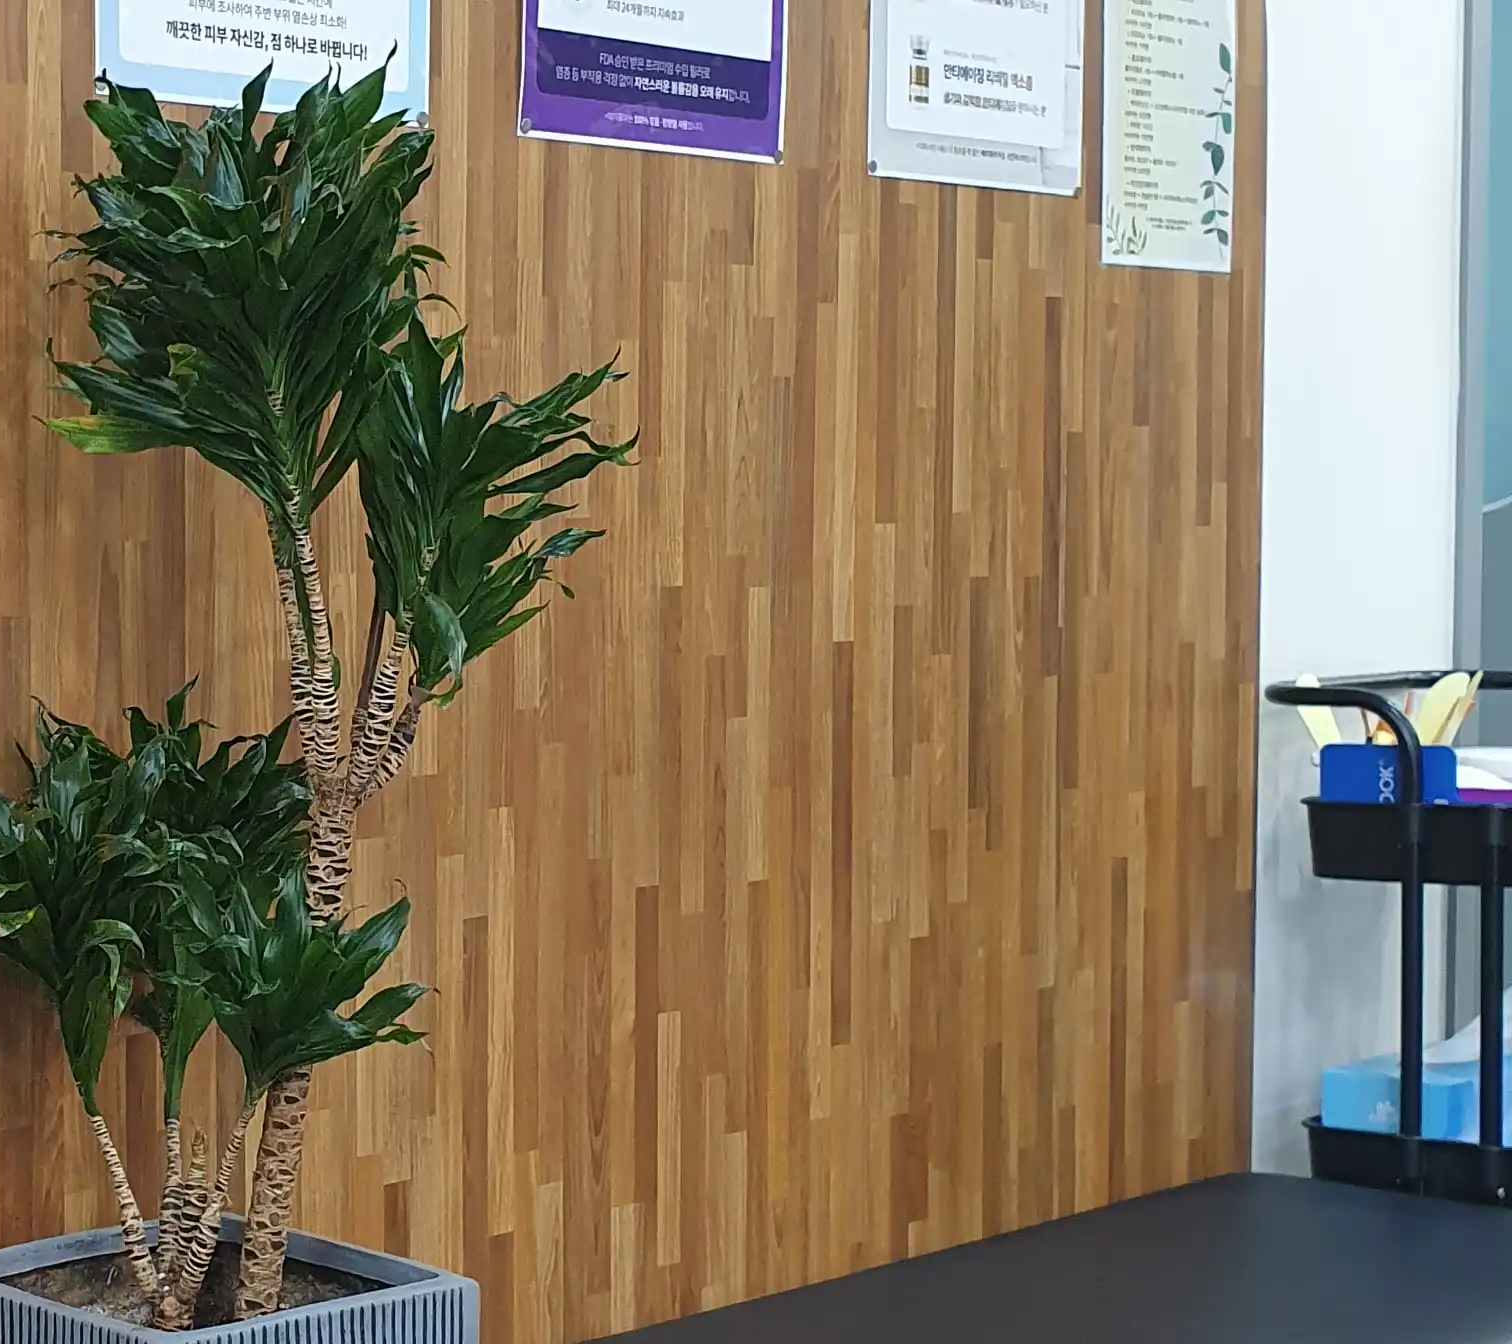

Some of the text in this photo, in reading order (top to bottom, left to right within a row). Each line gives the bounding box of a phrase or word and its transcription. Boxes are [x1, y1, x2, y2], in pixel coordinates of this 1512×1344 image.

[165, 18, 367, 63] 깨끗한 피부 자신감, 점 하나로 바뀝니다!
